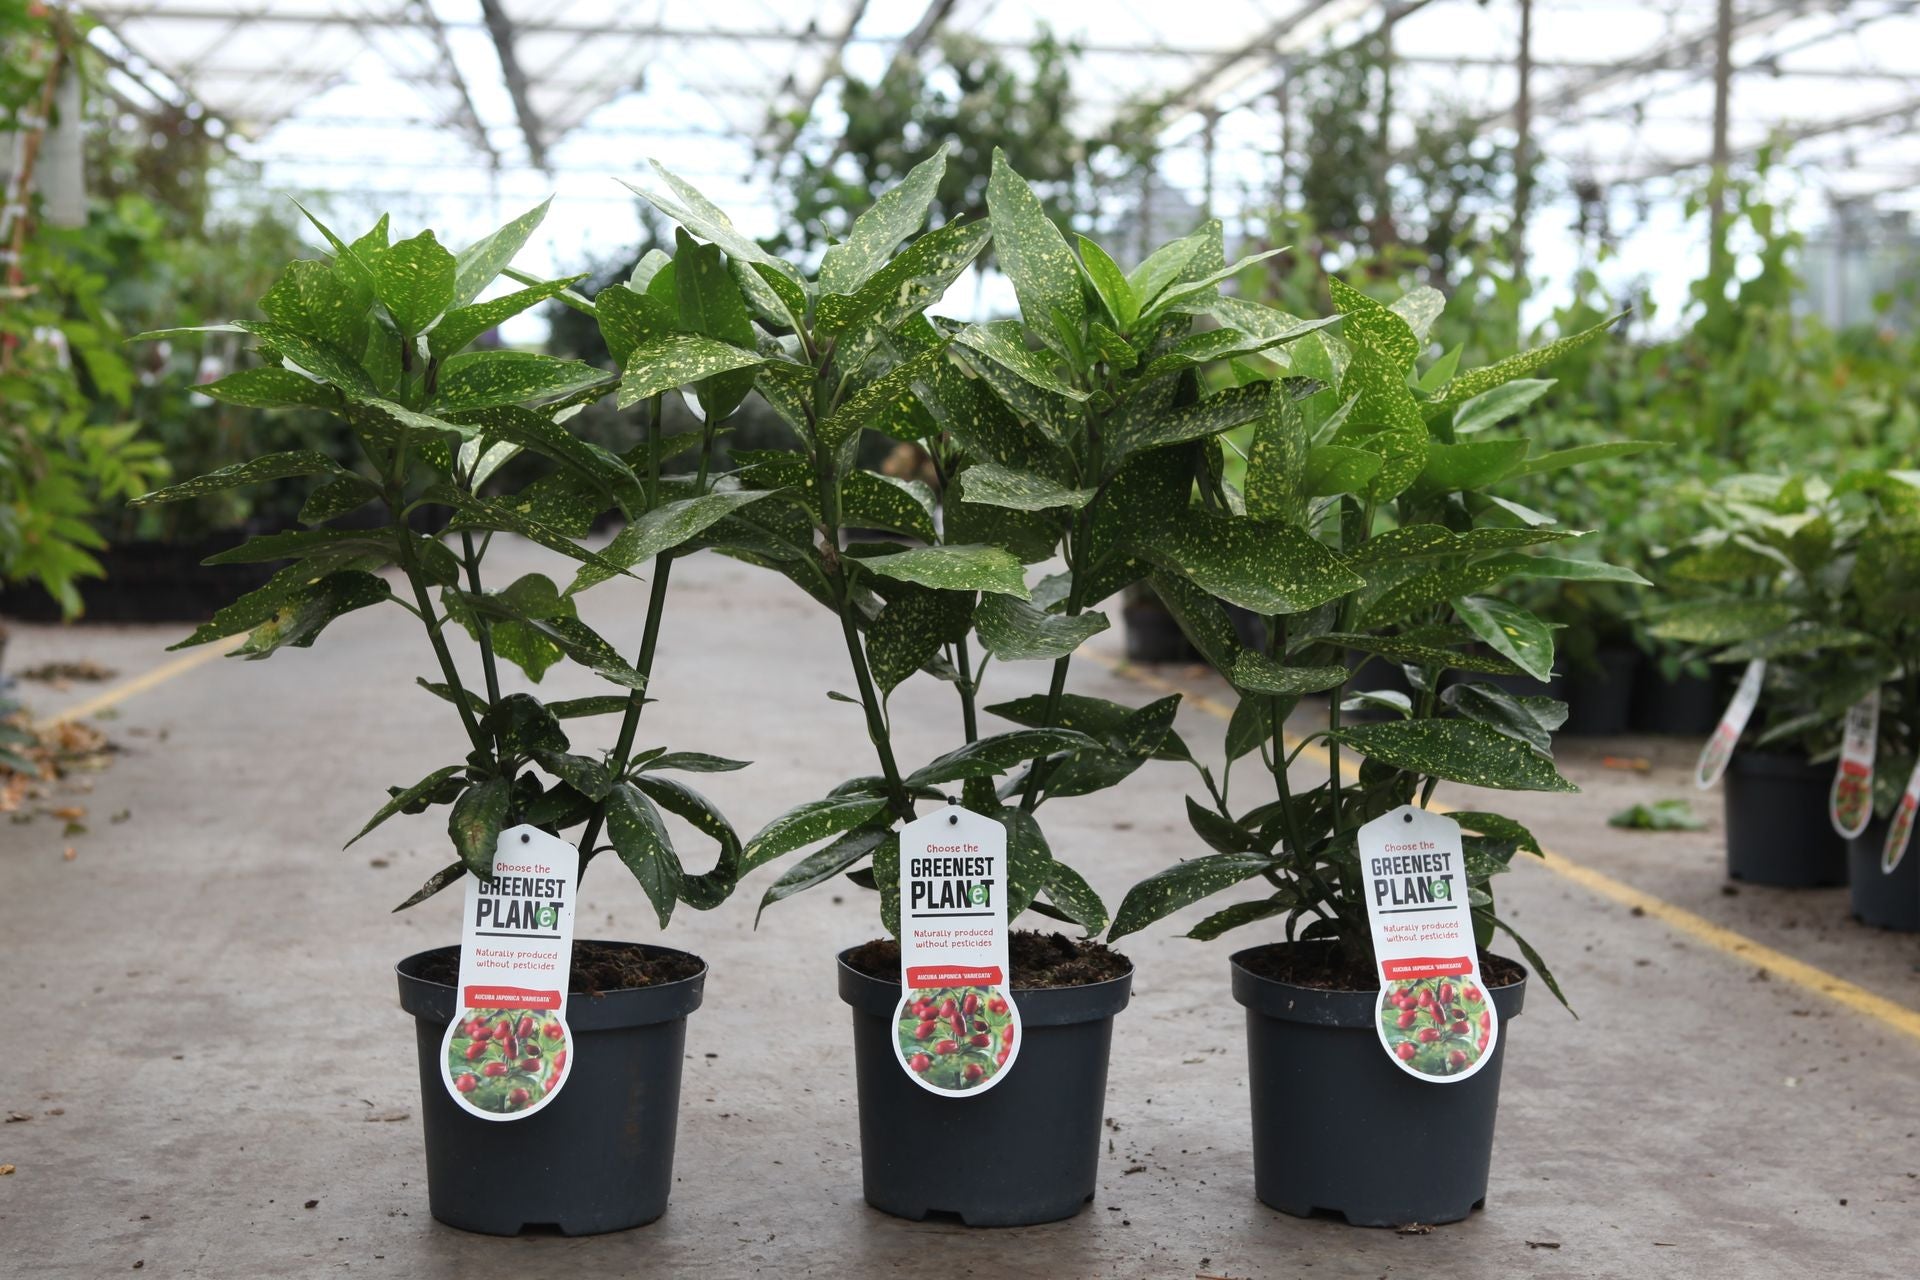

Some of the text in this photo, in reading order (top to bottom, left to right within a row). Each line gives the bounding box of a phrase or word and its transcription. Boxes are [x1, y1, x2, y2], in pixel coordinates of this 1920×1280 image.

[927, 844, 978, 853] Choose the
[1385, 841, 1434, 852] Choose the
[497, 862, 550, 873] Choose the
[911, 857, 994, 878] GREENEST
[1371, 853, 1451, 876] GREENEST
[478, 876, 566, 898] GREENEST
[1383, 921, 1458, 933] Naturally produced
[914, 928, 993, 938] Naturally produced
[1386, 932, 1459, 943] without pesticides
[916, 939, 992, 948] without pesticides
[475, 948, 558, 960] Naturally produced
[477, 960, 555, 970] without pesticides
